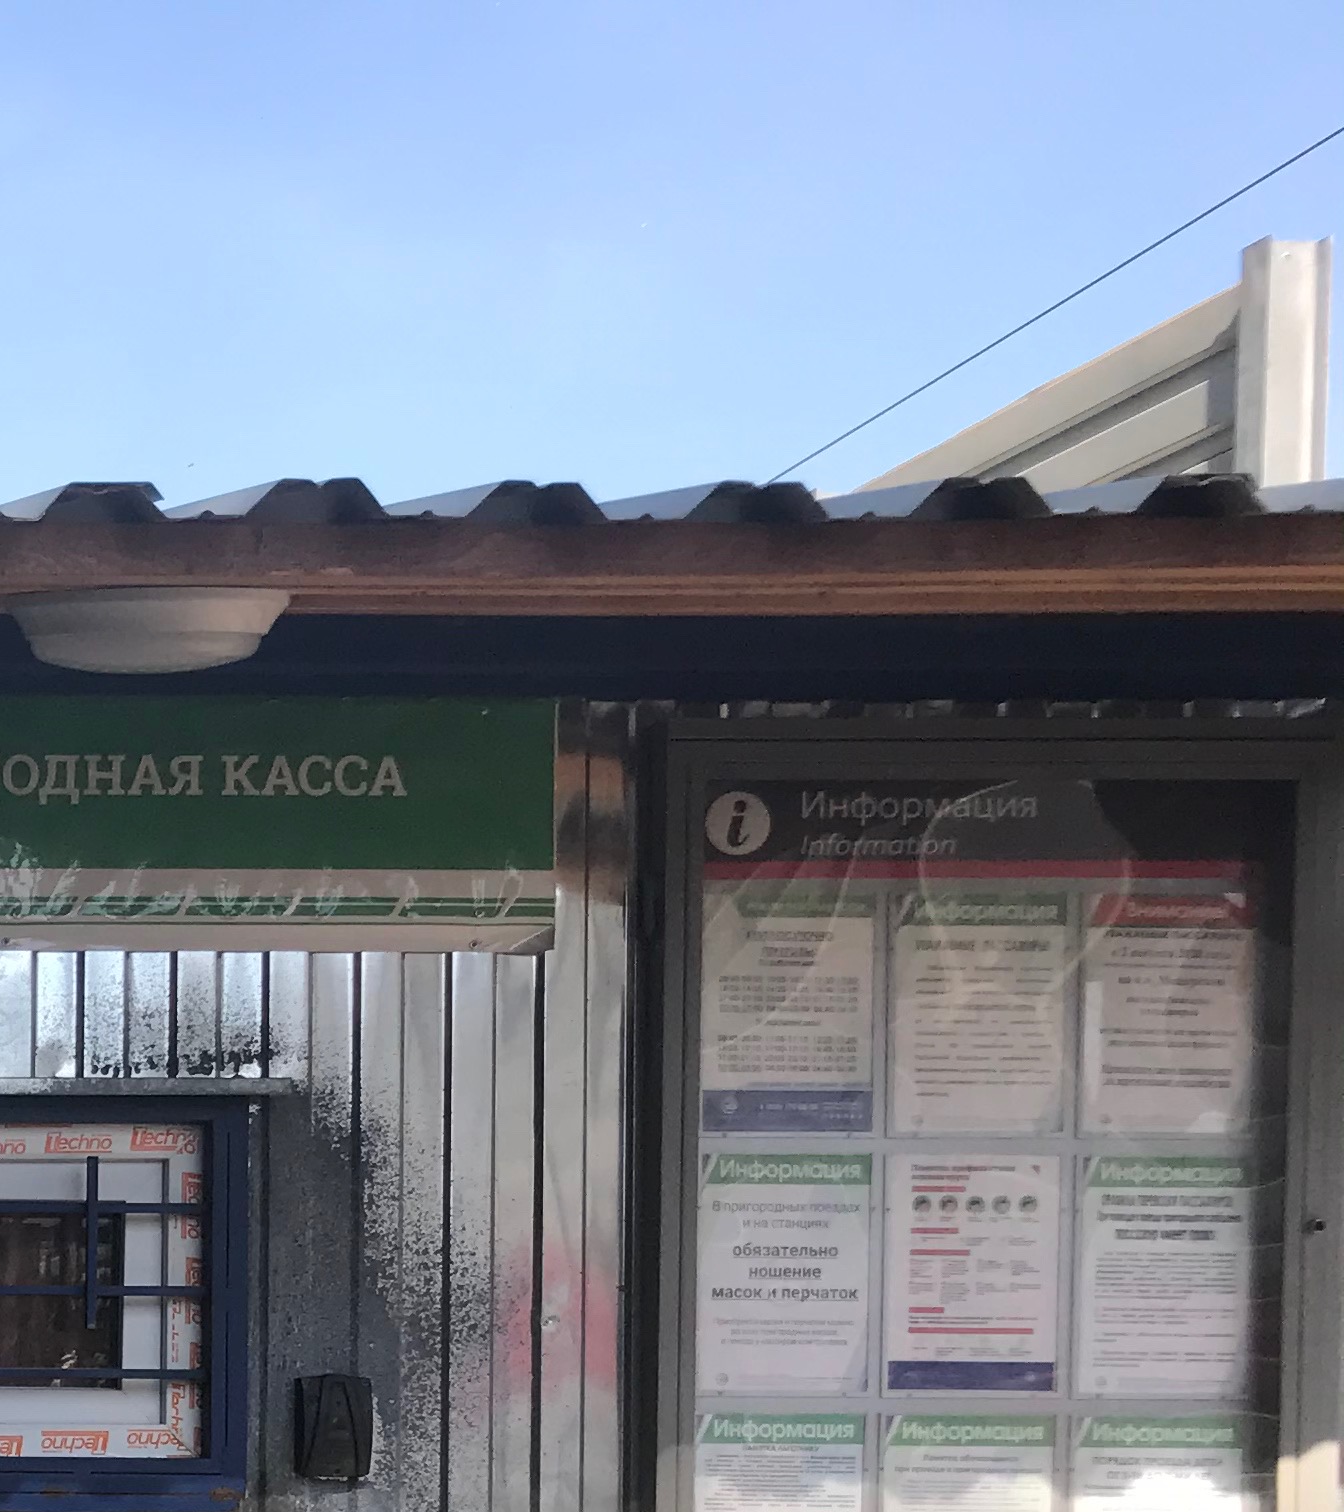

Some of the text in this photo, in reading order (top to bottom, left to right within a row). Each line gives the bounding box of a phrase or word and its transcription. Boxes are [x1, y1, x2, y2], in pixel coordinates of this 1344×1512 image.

[221, 755, 407, 797] КАССА
[801, 791, 1038, 826] Информация
[801, 833, 957, 856] Information
[44, 1132, 113, 1154] Techno
[719, 1160, 862, 1182] Информация
[1101, 1162, 1243, 1184] Информация
[712, 1201, 861, 1214] В пригородных поездах
[743, 1219, 829, 1230] и на станциях
[733, 1242, 839, 1259] обязательно
[749, 1266, 822, 1280] ношение
[711, 1287, 859, 1302] масок и перчаток
[713, 1419, 854, 1441] Информация
[902, 1421, 1044, 1443] Информация
[1092, 1421, 1234, 1443] Информация
[41, 1431, 109, 1455] Techno
